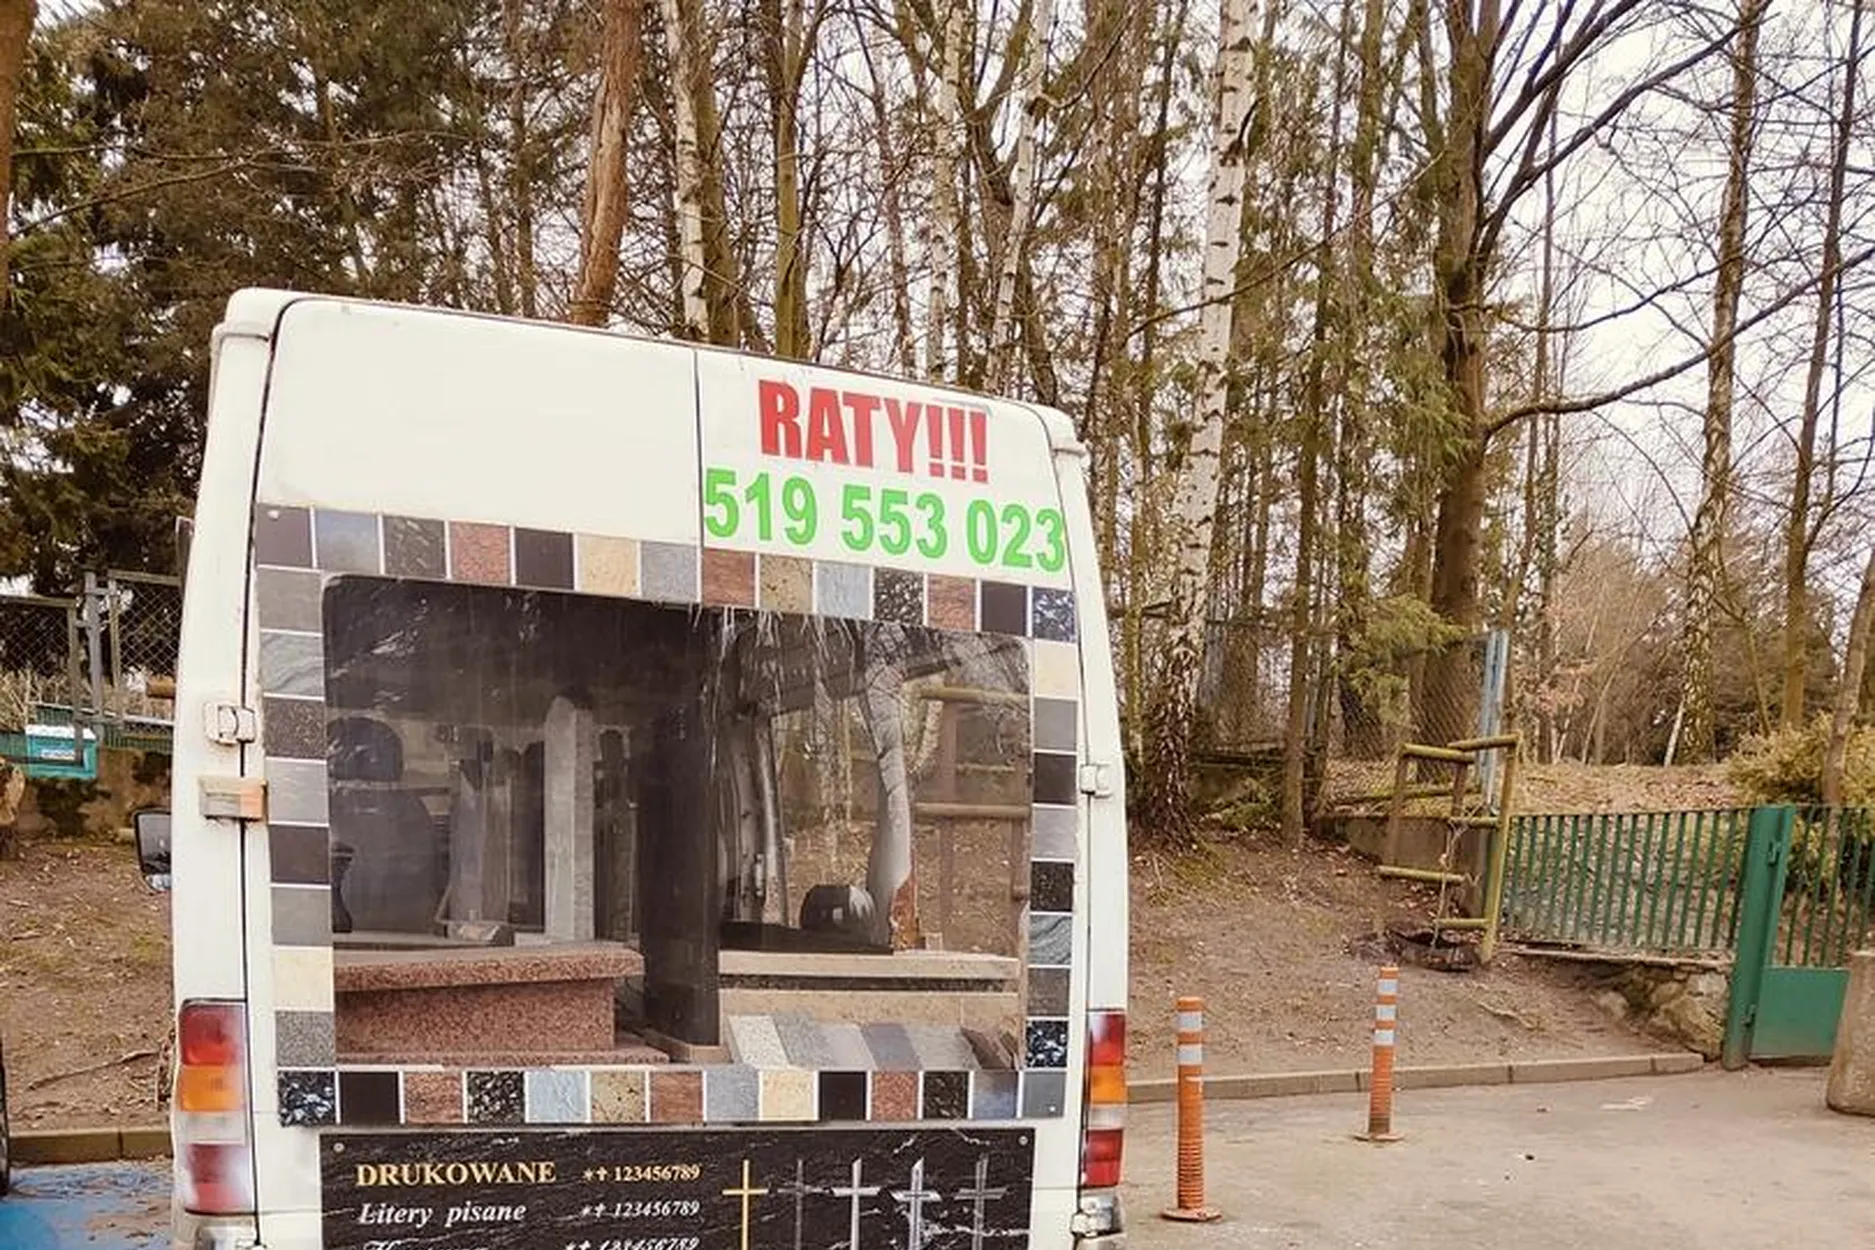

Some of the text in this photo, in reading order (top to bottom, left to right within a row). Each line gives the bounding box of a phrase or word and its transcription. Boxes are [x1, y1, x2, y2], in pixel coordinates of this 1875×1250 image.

[758, 379, 989, 484] RATY!!!
[705, 468, 1065, 573] 519 553 023
[355, 1162, 701, 1187] DRUKOWANE 123456789
[358, 1200, 700, 1227] Litery pisane 123456789
